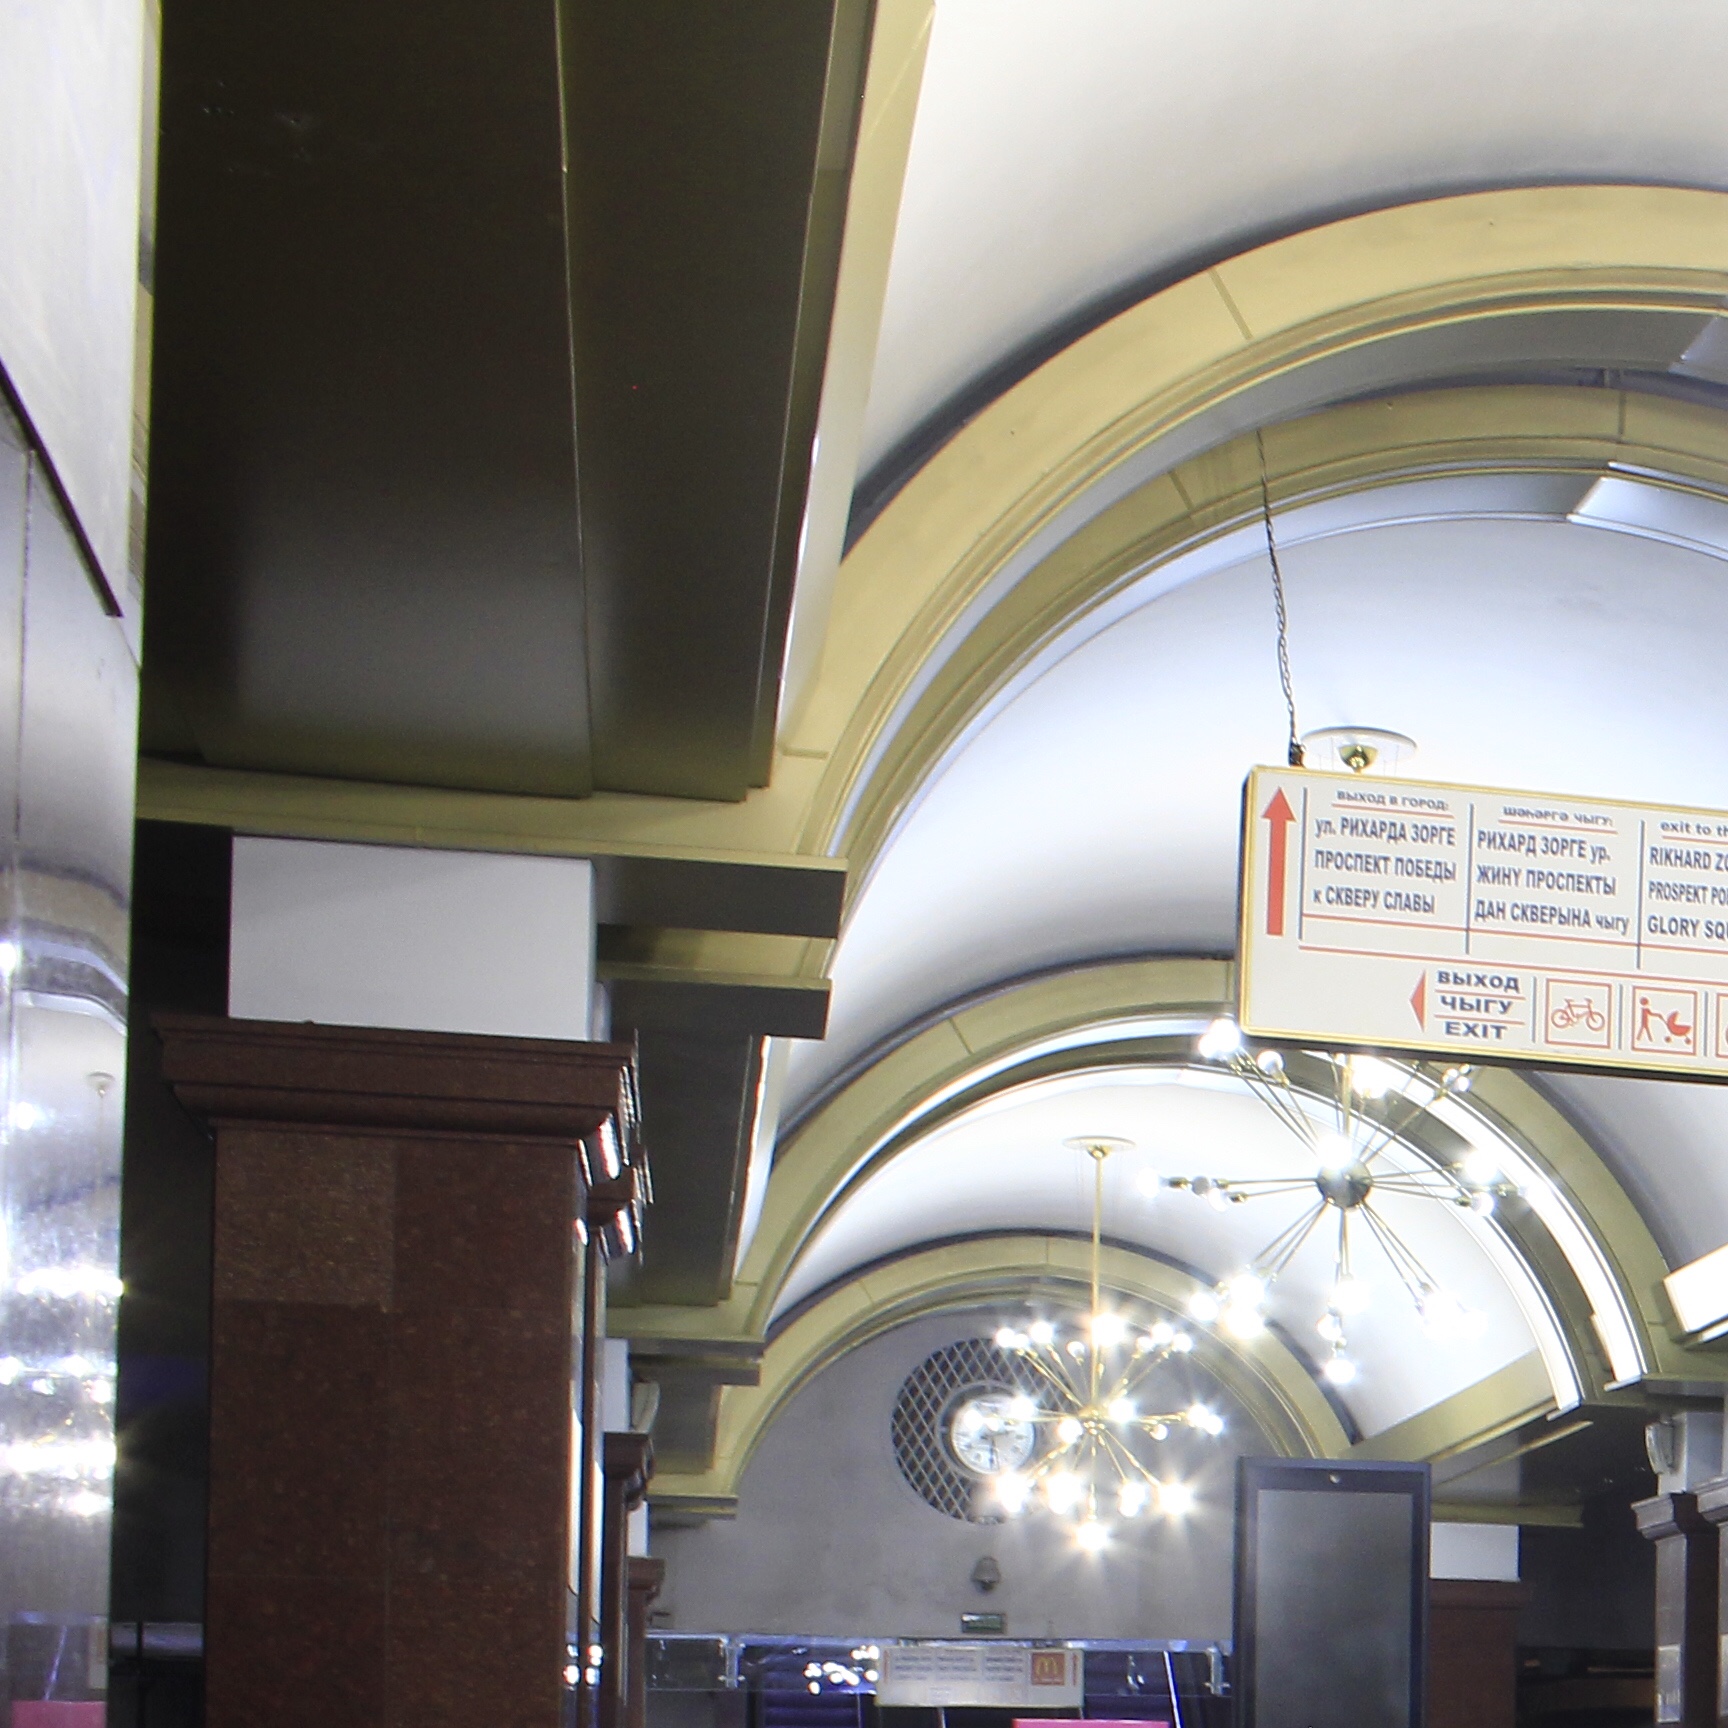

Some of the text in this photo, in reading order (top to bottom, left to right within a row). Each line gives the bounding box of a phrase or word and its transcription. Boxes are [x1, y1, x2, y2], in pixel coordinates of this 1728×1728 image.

[1315, 817, 1455, 845] ул. РИХАРДА ЗОРГЕ
[1660, 821, 1690, 833] exit
[1696, 824, 1711, 835] to
[1478, 830, 1610, 864] РИХАРД ЗОРГЕ ур.
[1650, 846, 1711, 870] RIKHARD
[1314, 849, 1456, 882] ПРОСПЕКТ ПОБЕДЫ
[1526, 869, 1616, 895] ПРОСПЕКТЫ
[1649, 881, 1707, 905] PROSPEKT
[1313, 886, 1435, 913] к СКВЕРУ СЛАВЫ
[1475, 899, 1629, 935] ДАН СКВЕРЫНА чыгу
[1648, 915, 1699, 937] GLORY
[1438, 971, 1520, 994] ВЫХОД
[1441, 996, 1512, 1014] ЧЫГУ
[1446, 1022, 1507, 1039] EXIT
